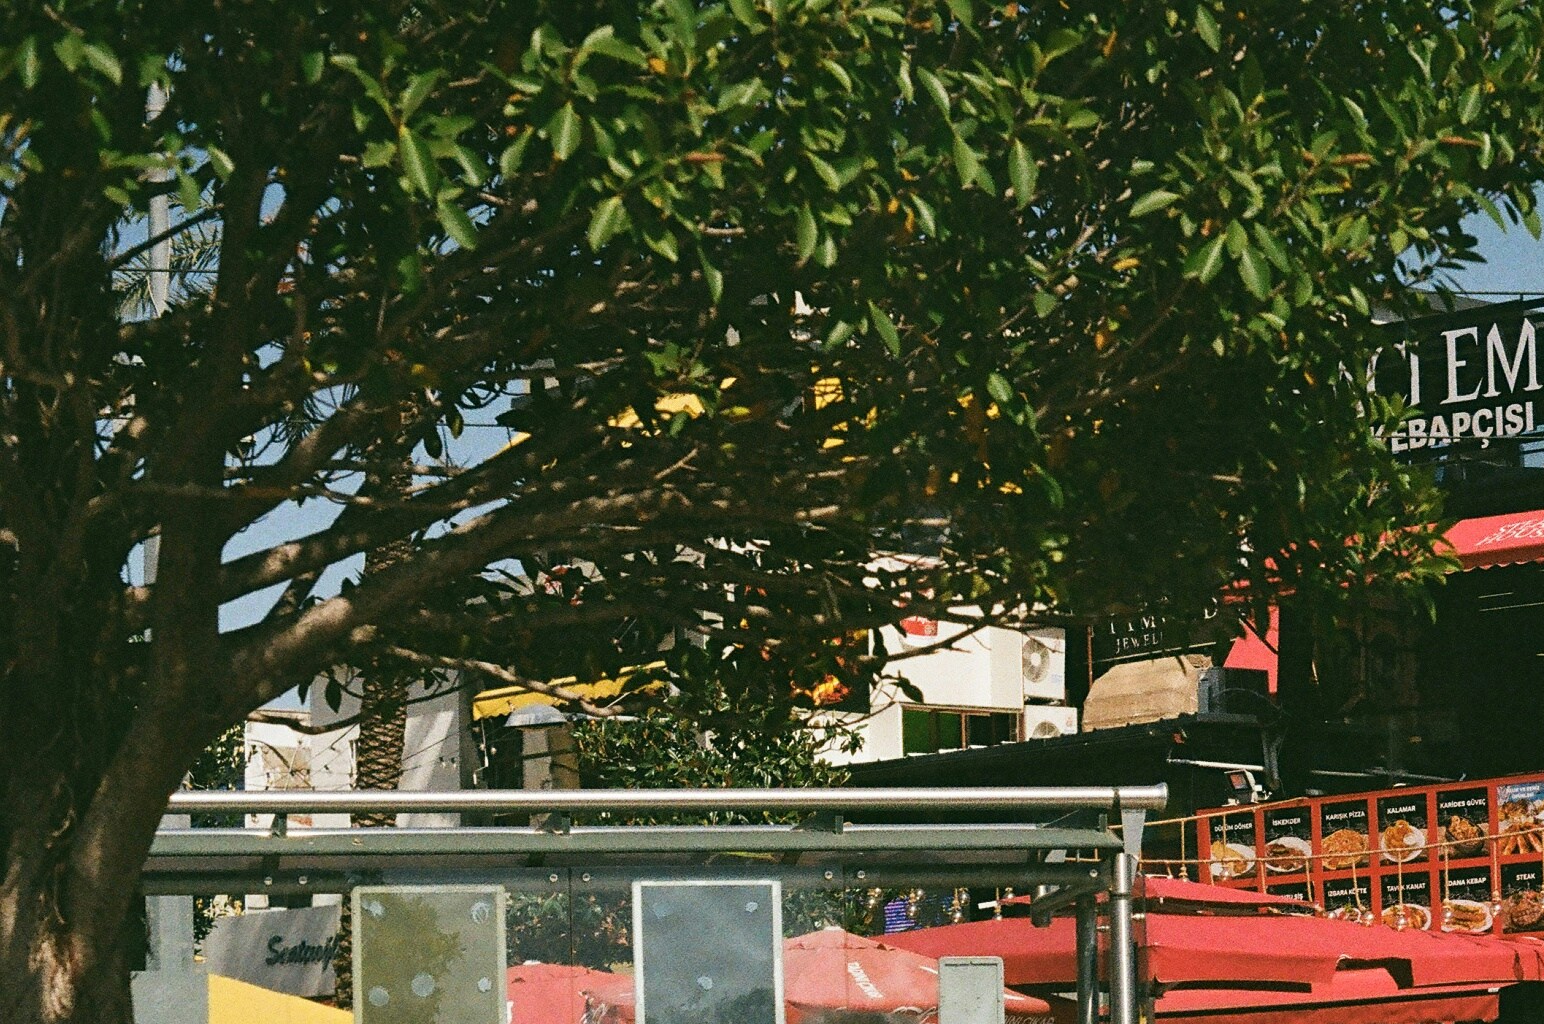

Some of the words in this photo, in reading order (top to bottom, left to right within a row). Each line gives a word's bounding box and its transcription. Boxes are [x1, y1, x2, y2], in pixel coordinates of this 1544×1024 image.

[1387, 806, 1416, 814] KALAMAR
[1326, 813, 1347, 821] KARIŞIK
[1347, 810, 1366, 819] PİZZA
[1272, 817, 1301, 826] İSKENDER
[1234, 822, 1253, 831] DÖNER
[1462, 877, 1487, 886] KEBAP
[1516, 873, 1536, 881] STEAK
